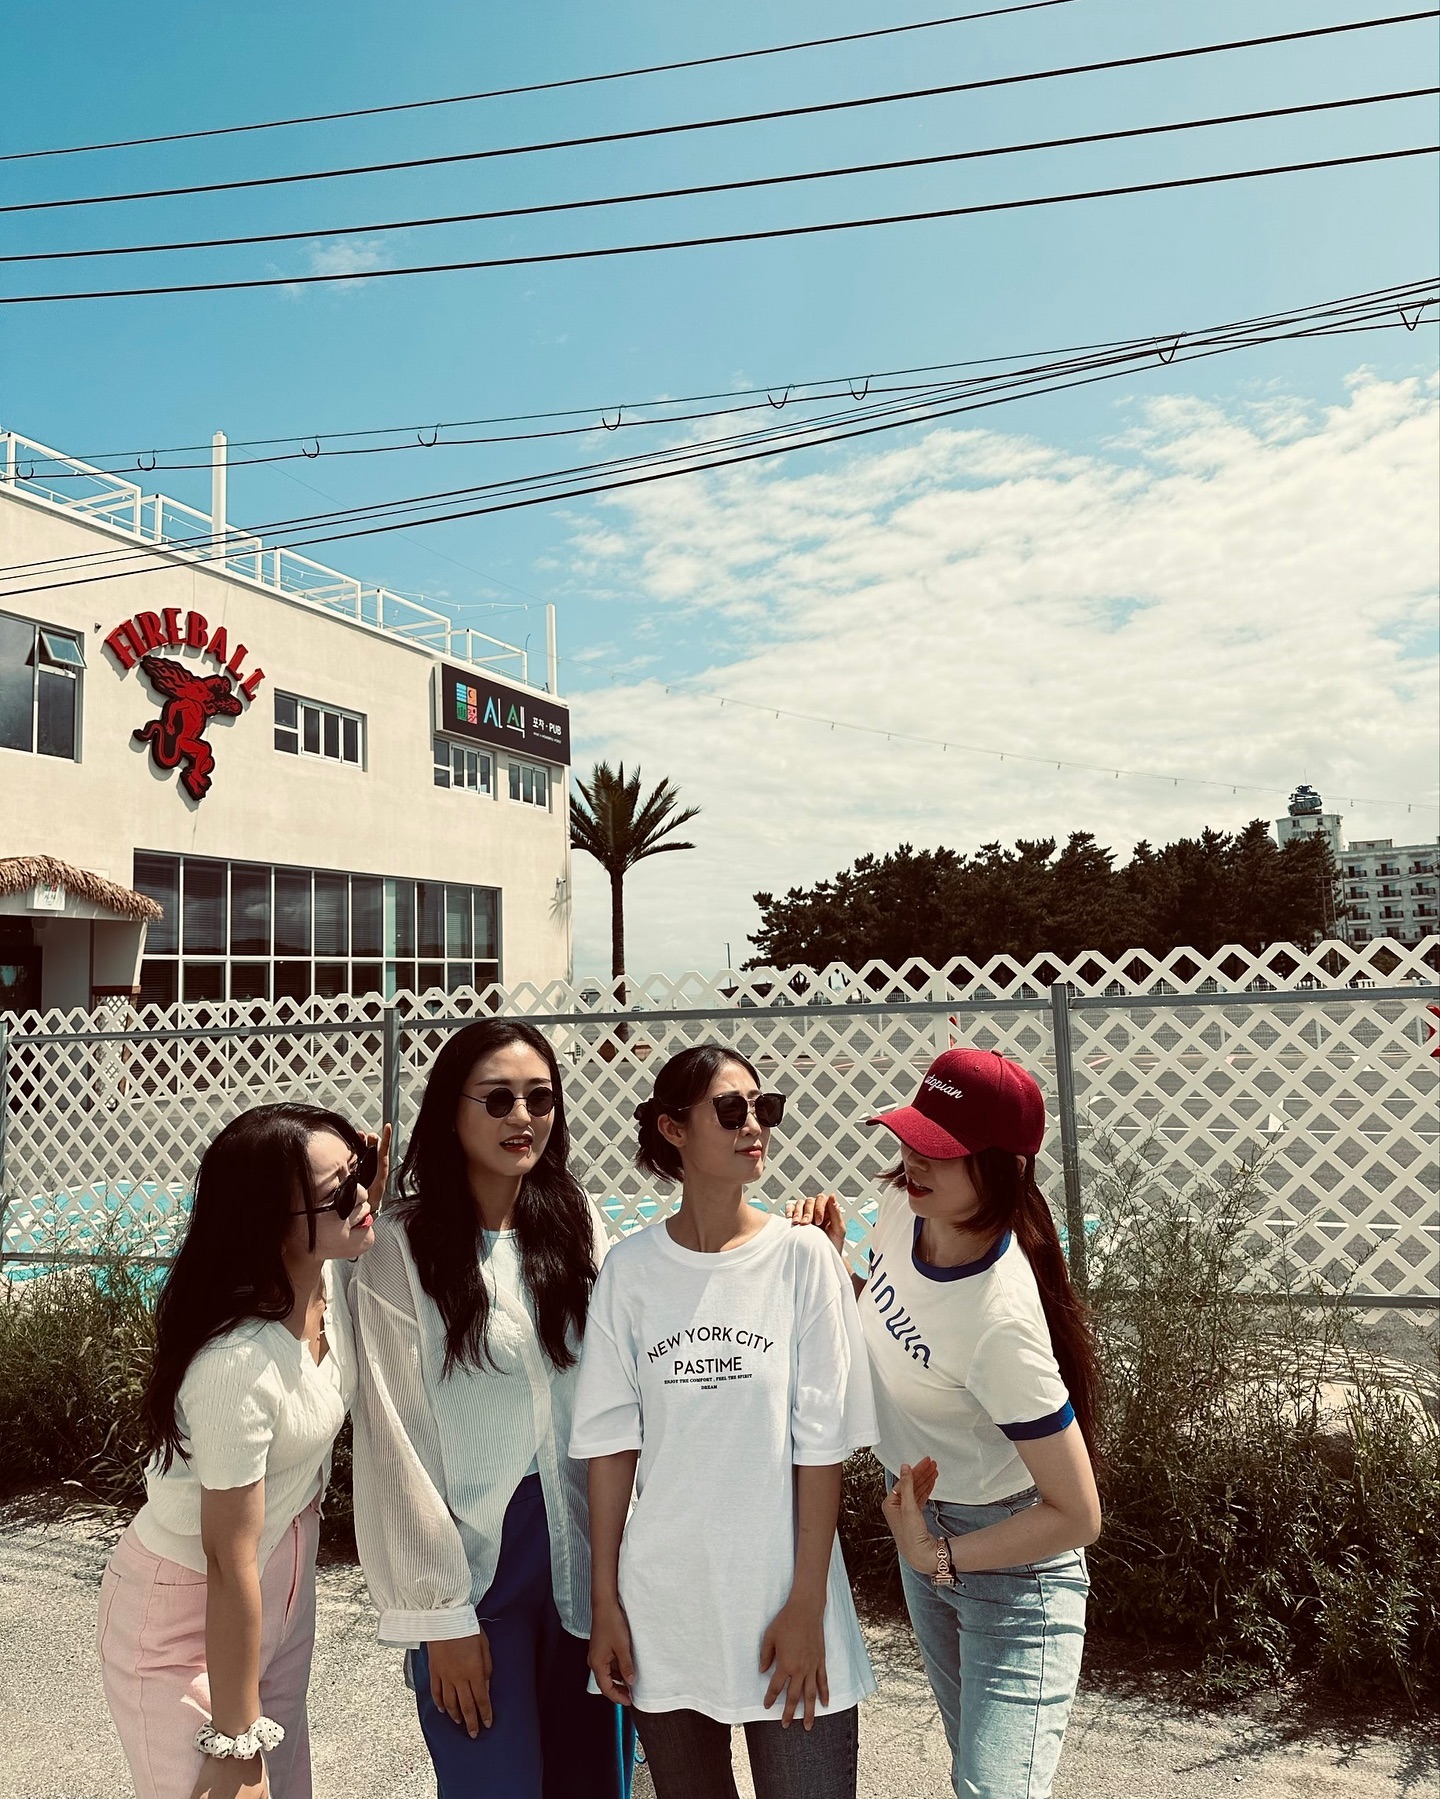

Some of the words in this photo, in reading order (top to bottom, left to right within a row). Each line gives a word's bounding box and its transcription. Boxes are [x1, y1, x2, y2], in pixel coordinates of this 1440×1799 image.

[104, 608, 266, 702] FIREBALL
[549, 722, 562, 736] PUB
[647, 1332, 681, 1363] NEW
[685, 1327, 733, 1343] YORK
[736, 1330, 774, 1353] CITY
[674, 1356, 742, 1375] PASTIME
